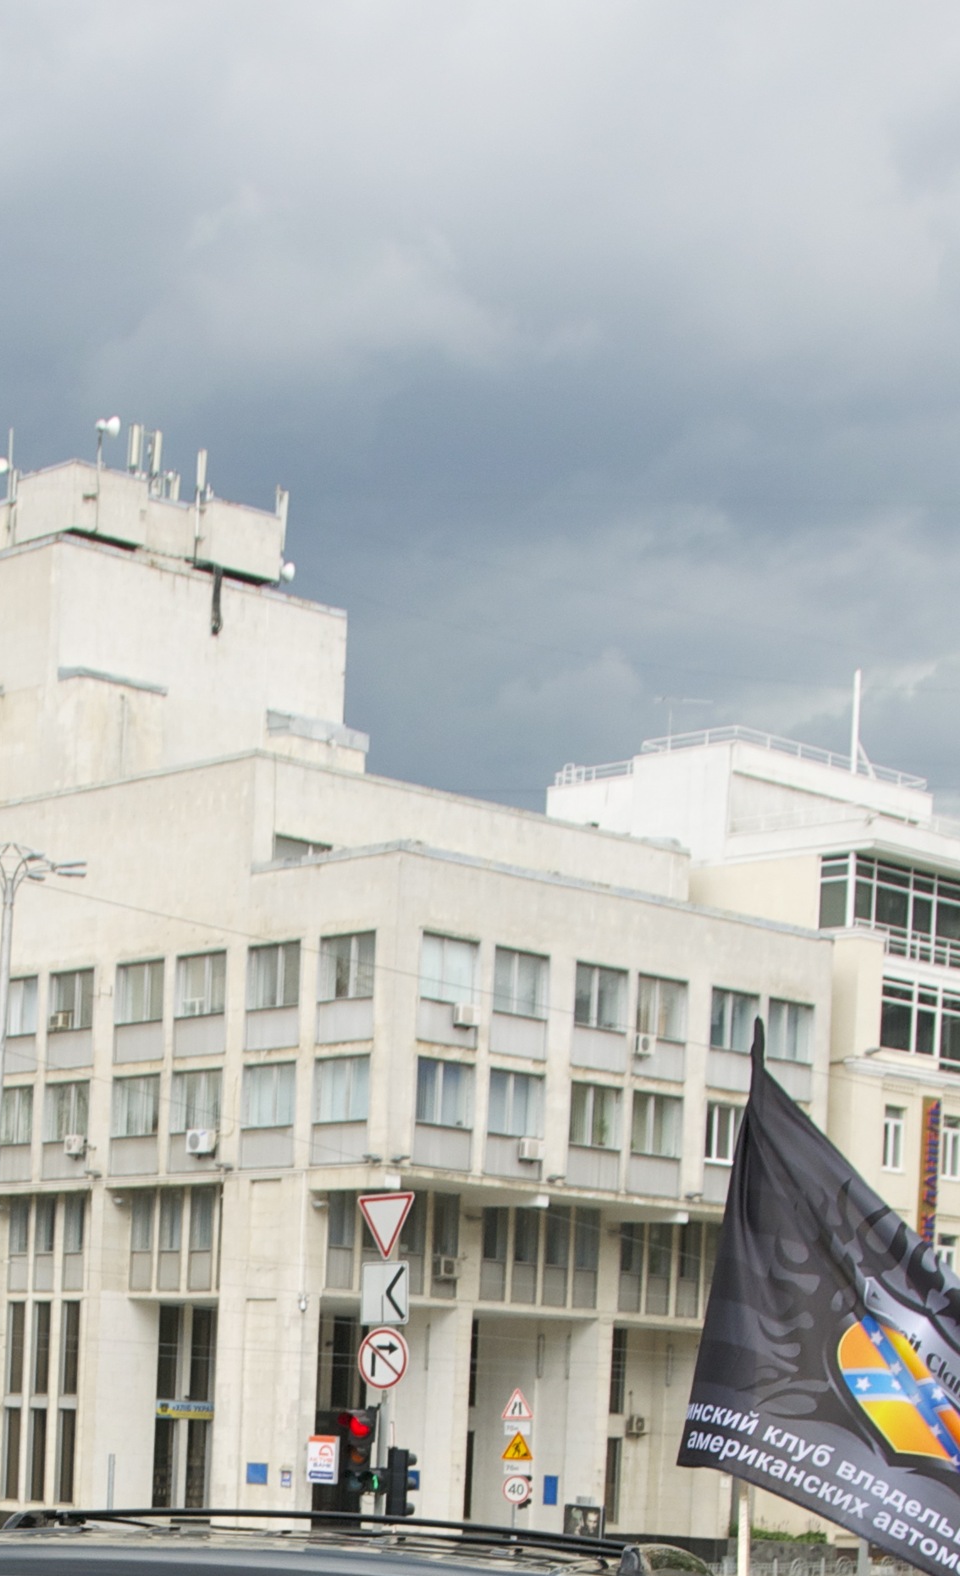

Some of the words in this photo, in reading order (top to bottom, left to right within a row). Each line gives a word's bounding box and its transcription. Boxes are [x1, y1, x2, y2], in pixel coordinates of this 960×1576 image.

[762, 1425, 836, 1468] клуб
[508, 1483, 525, 1496] 40
[686, 1430, 870, 1520] американских
